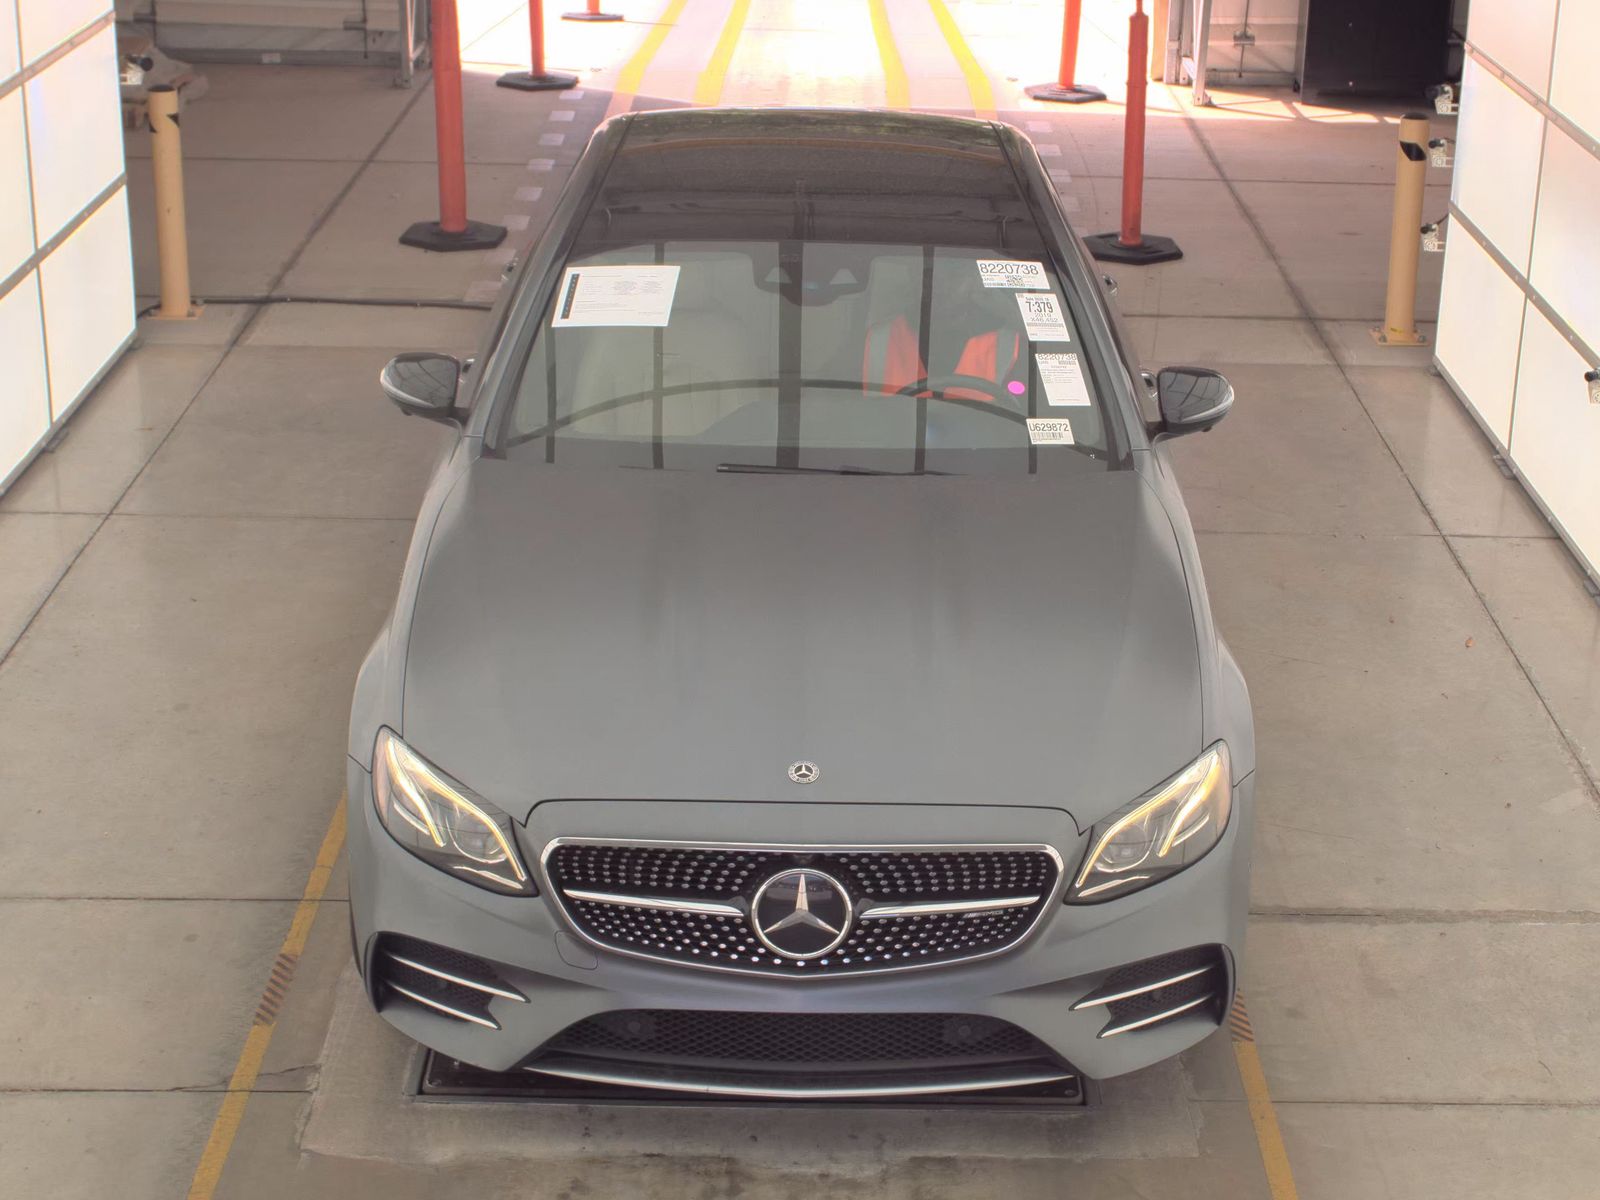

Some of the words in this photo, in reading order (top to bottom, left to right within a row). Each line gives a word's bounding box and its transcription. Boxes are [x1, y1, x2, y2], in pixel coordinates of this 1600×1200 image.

[980, 263, 1039, 275] 8220738
[1025, 301, 1053, 313] 7:379
[1029, 423, 1069, 431] U629872
